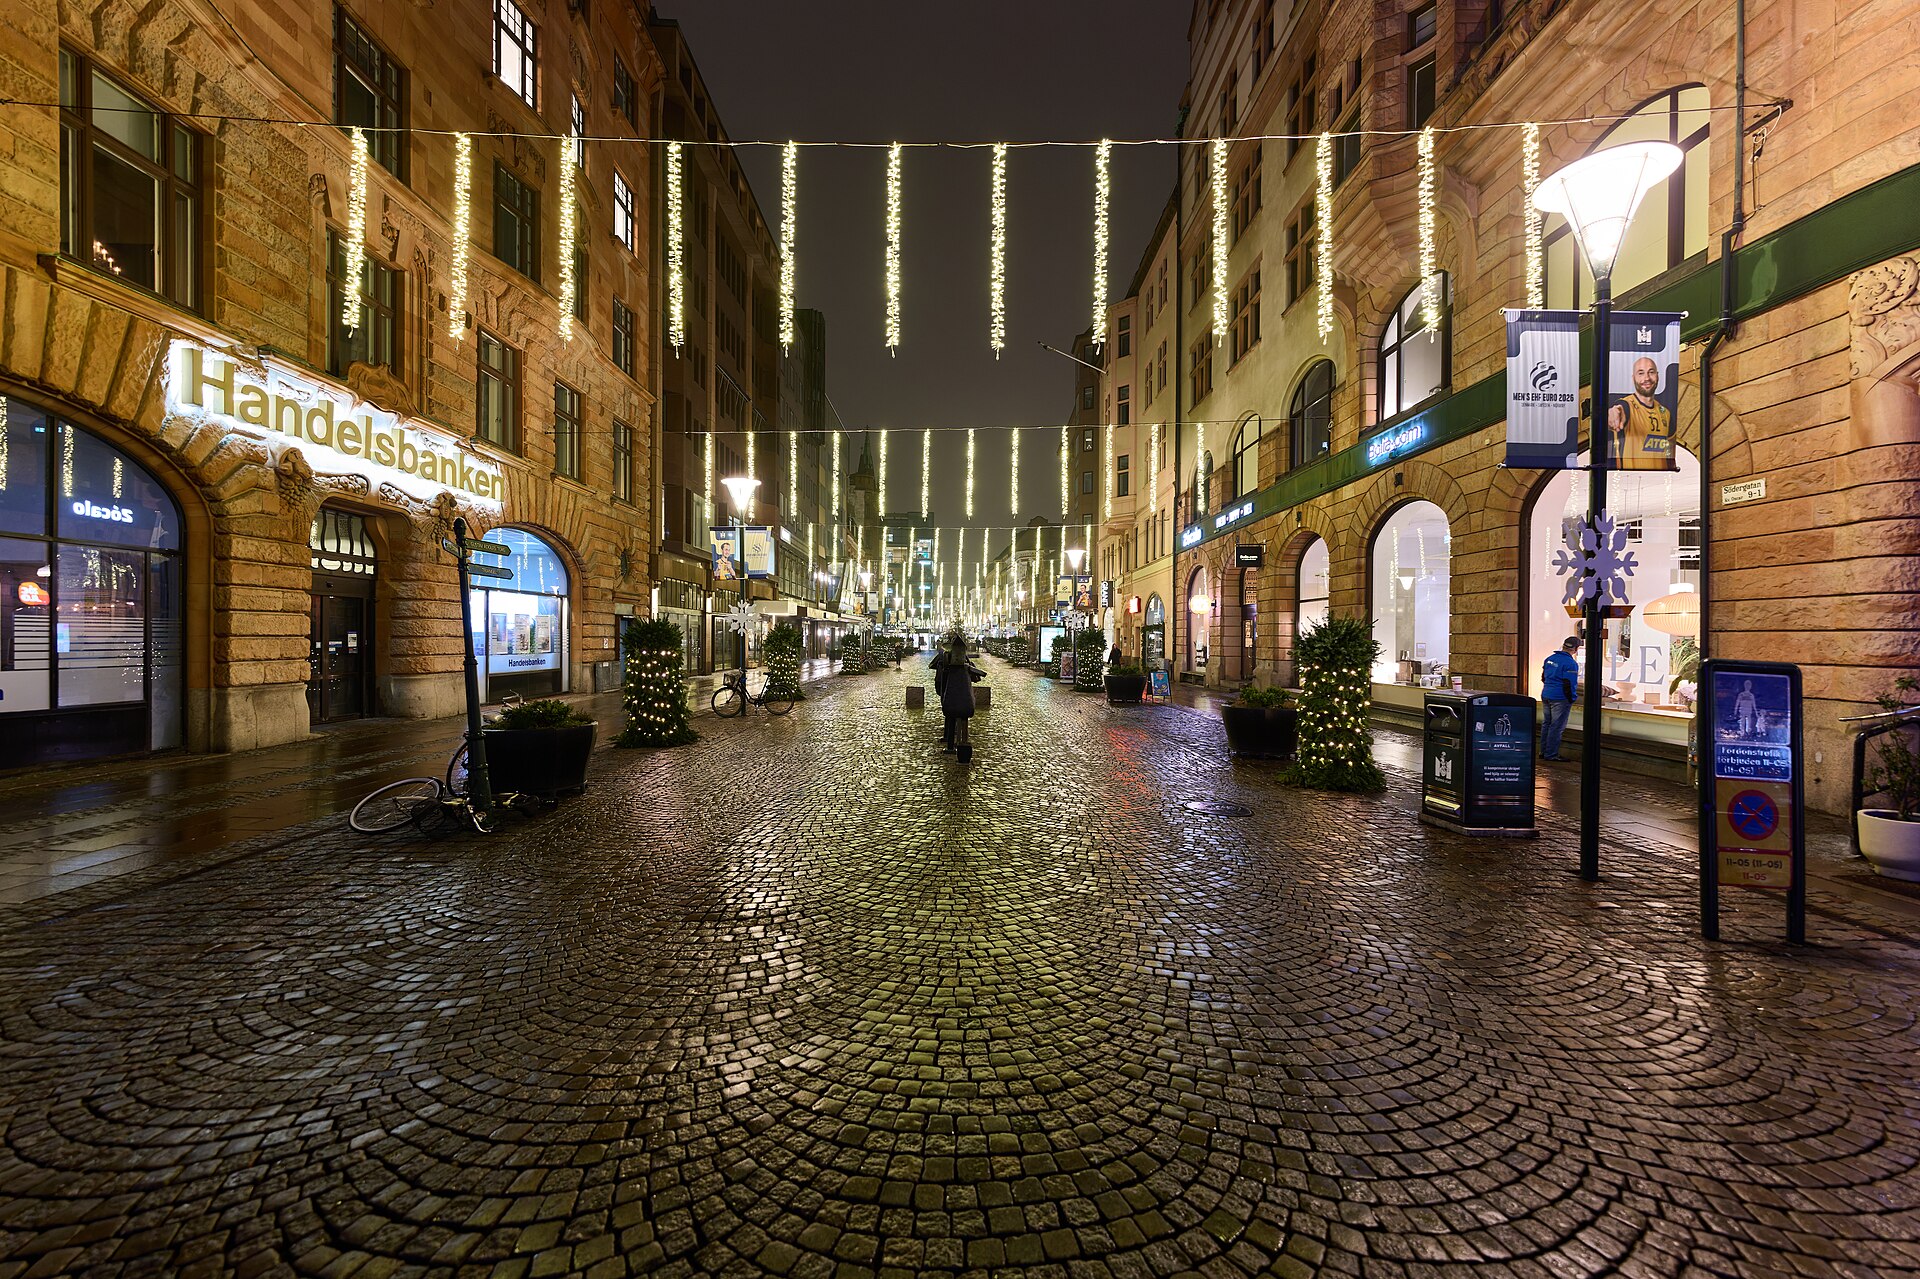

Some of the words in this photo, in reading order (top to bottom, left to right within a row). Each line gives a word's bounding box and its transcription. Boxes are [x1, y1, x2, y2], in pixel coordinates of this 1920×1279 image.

[1513, 392, 1530, 401] MEN'S
[1531, 393, 1541, 401] EHF
[1542, 393, 1557, 402] EURO
[1559, 394, 1574, 402] 2026
[181, 347, 505, 500] Handelsbanken
[1368, 425, 1422, 460] Bolia.com
[1644, 437, 1666, 450] ATG
[1723, 482, 1762, 494] Södergatan
[1747, 489, 1762, 499] 9-1
[508, 658, 546, 668] Handelsbanken
[1721, 746, 1781, 758] Fordonstrafik
[1717, 756, 1761, 767] förbjuden
[1726, 858, 1749, 867] 11-05
[1752, 859, 1783, 869] (11-05)
[1743, 871, 1767, 881] 11-05
